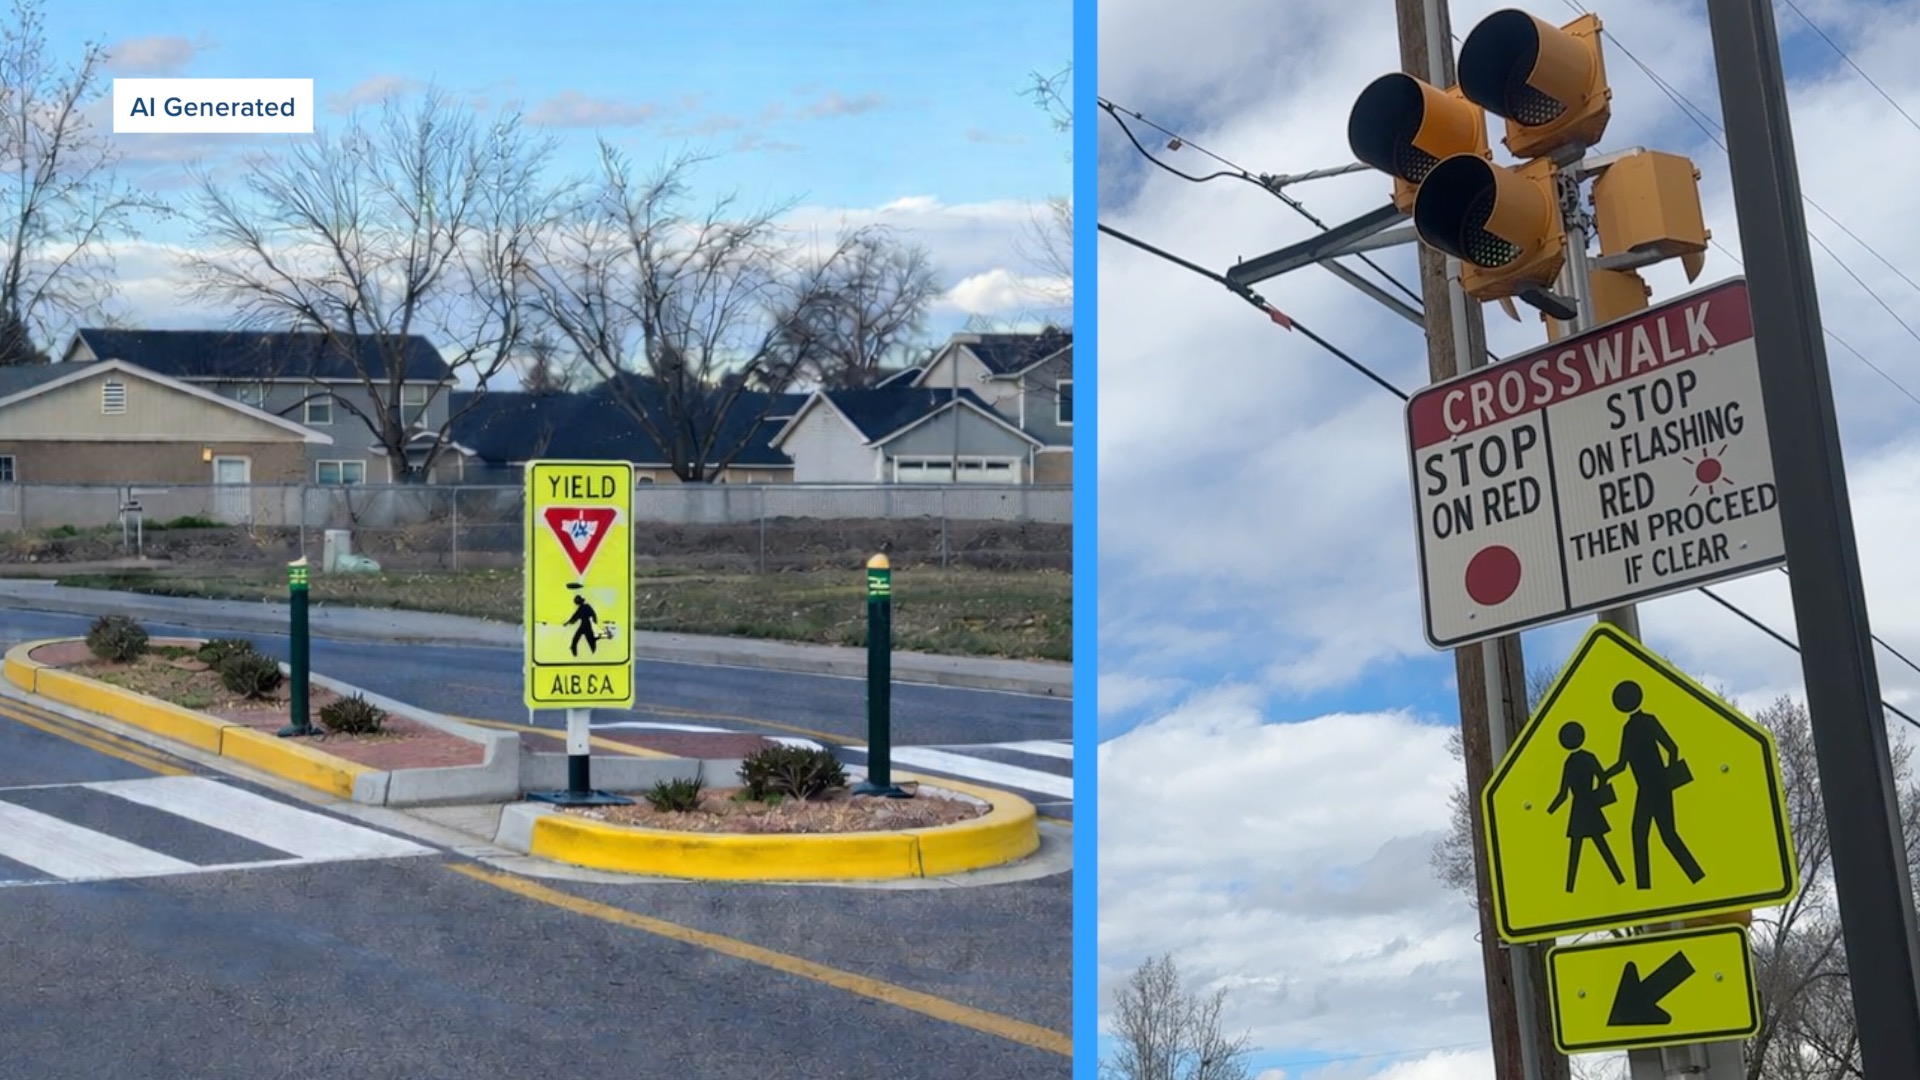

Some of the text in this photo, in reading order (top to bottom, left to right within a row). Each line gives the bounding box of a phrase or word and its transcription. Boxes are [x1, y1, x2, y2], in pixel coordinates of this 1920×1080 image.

[1443, 301, 1718, 433] CROSSWALK
[1606, 369, 1697, 430] STOP
[1424, 424, 1537, 497] STOP
[1579, 401, 1744, 480] ON FLASHING
[548, 475, 616, 499] YIELD
[1433, 476, 1541, 540] ON RED
[1599, 471, 1655, 520] RED
[1570, 482, 1778, 562] THEN PROCEED
[1624, 532, 1730, 585] IF CLEAR
